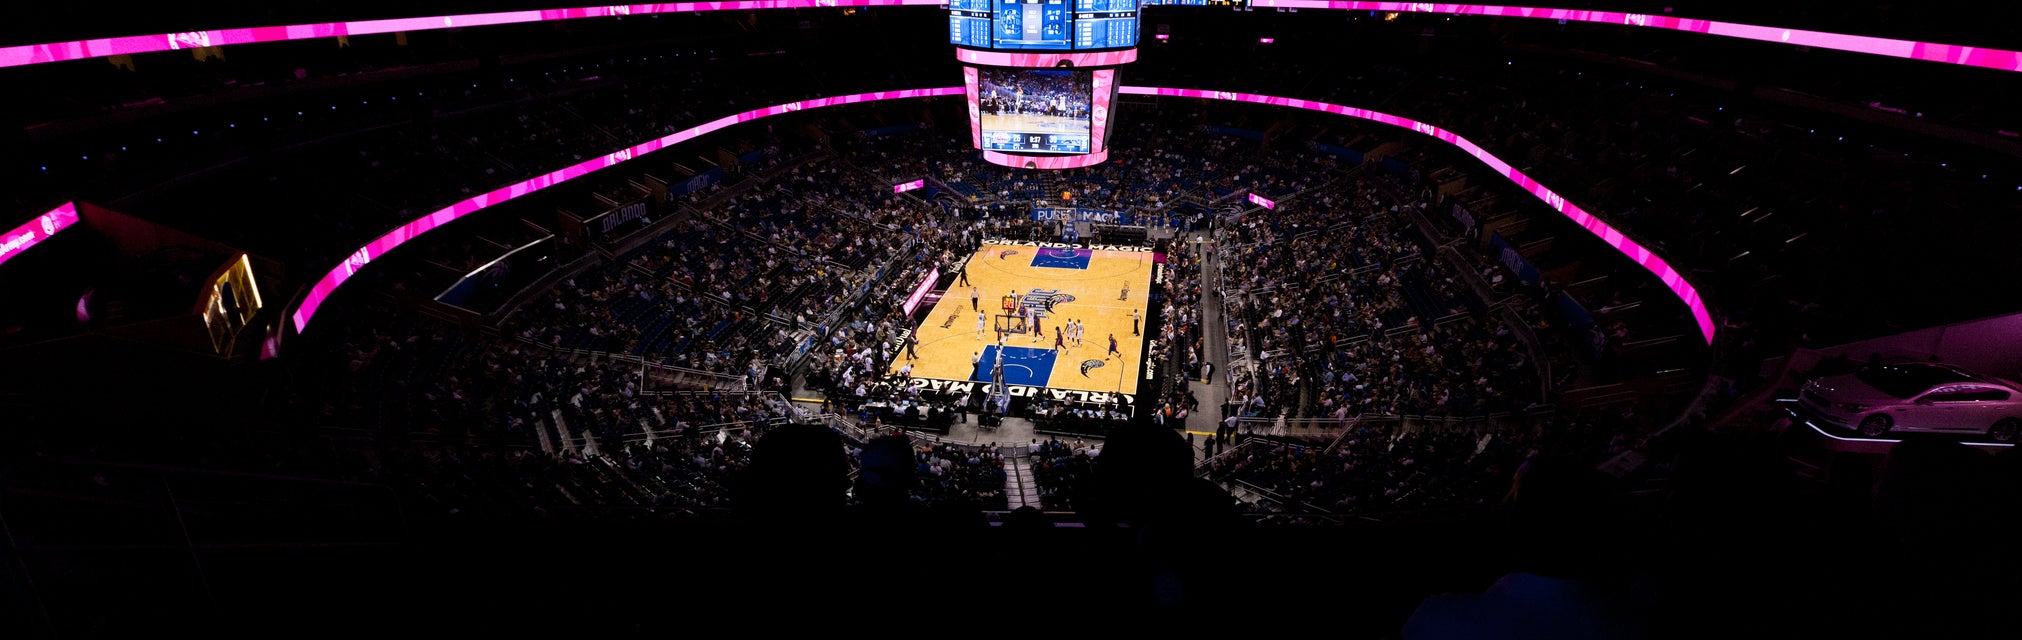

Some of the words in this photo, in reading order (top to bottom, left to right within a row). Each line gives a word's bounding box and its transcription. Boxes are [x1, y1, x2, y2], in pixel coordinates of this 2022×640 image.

[601, 202, 647, 233] ORLANDO
[1082, 211, 1119, 222] MAG
[984, 239, 1082, 249] ORLANDO
[1088, 244, 1153, 253] MAGIC
